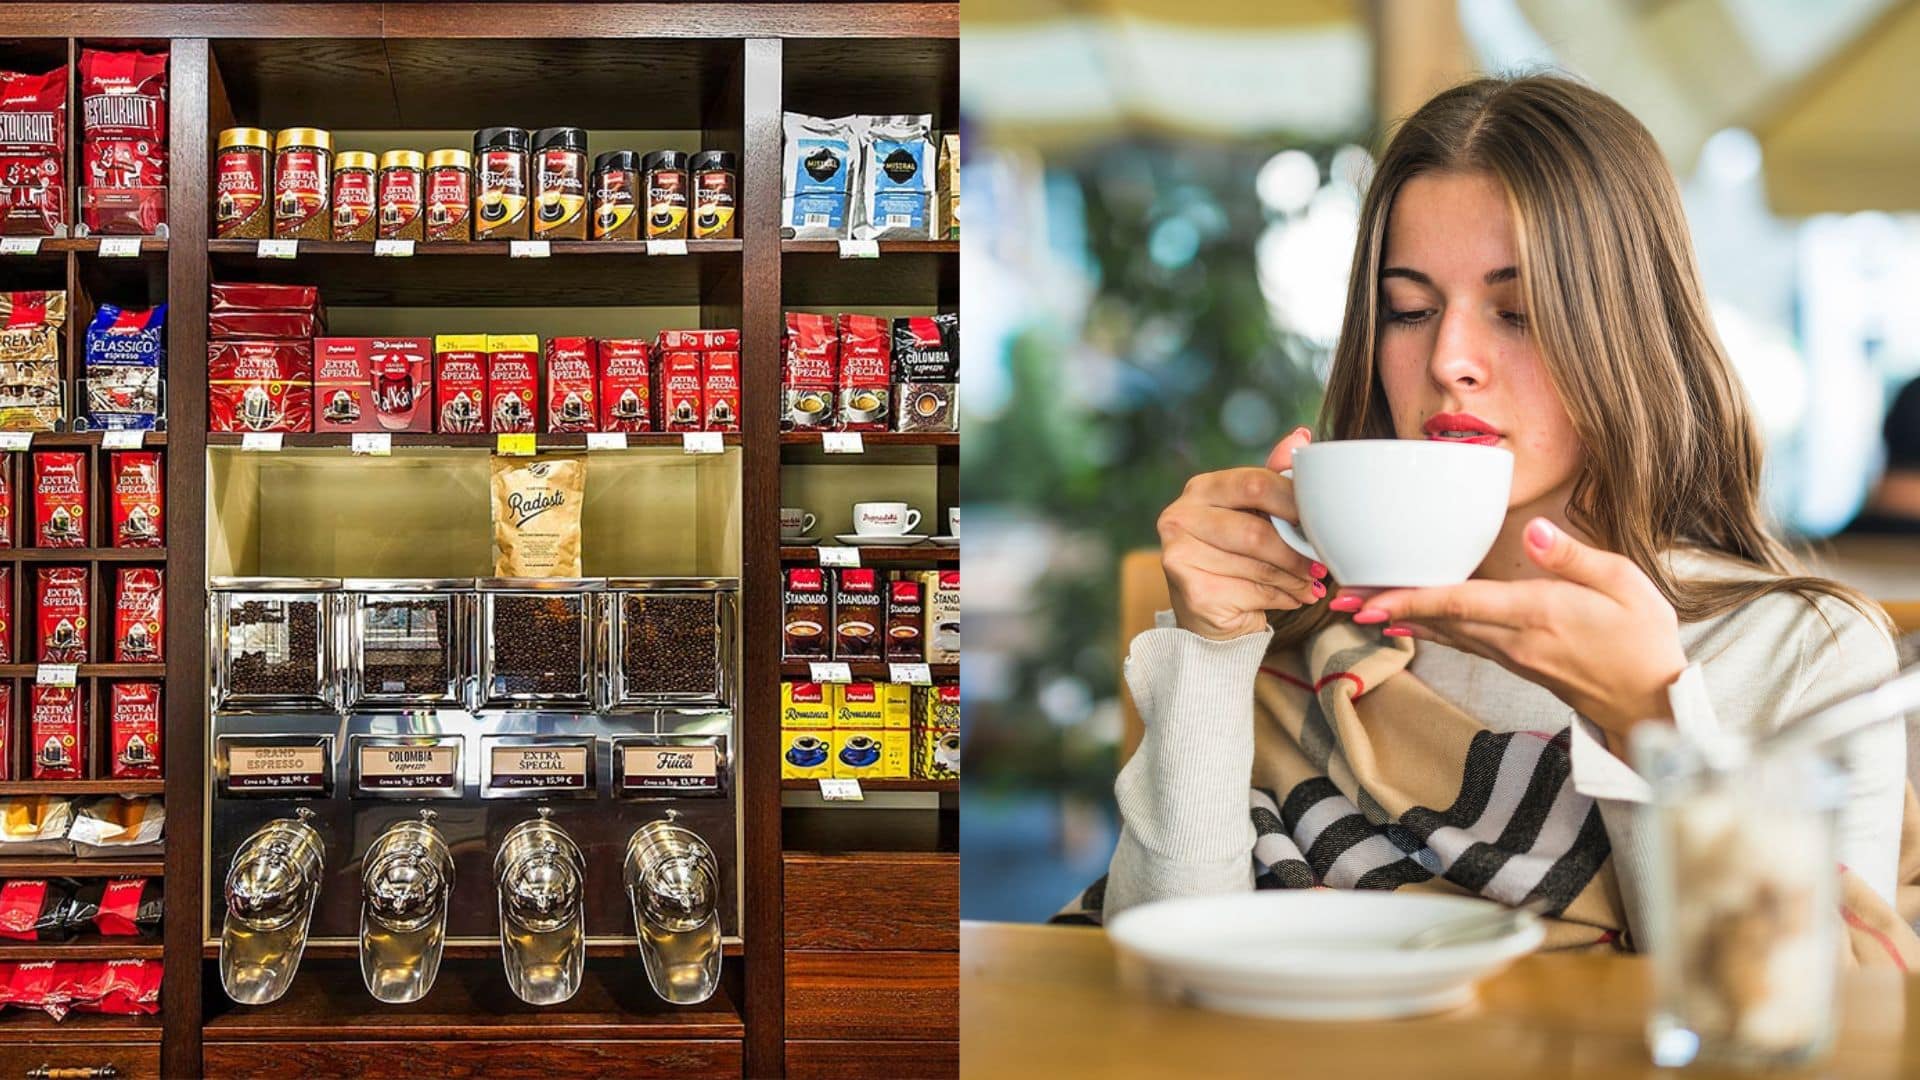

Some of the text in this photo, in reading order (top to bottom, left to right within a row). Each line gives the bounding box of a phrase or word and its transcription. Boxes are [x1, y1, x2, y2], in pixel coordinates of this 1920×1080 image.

[0, 115, 55, 144] STAURANT
[221, 171, 253, 180] EXTRA
[283, 170, 318, 180] EXTRA
[104, 353, 139, 361] espresso
[906, 351, 950, 364] COLOMBIA
[240, 358, 278, 368] EXTRA
[325, 359, 359, 369] EXTRA
[445, 362, 479, 371] EXTRA
[494, 362, 528, 371] EXTRA
[554, 360, 589, 369] EXTRA
[610, 358, 645, 367] EXTRA
[796, 359, 830, 368] EXTRA
[848, 358, 883, 367] EXTRA
[42, 475, 79, 484] EXTRA
[508, 489, 565, 519] Radosti
[47, 588, 82, 597] EXTRA
[121, 592, 157, 601] EXTRA
[785, 591, 828, 605] ŠTANDARD
[837, 591, 880, 605] ŠTANDARD
[36, 704, 71, 714] EXTRA
[117, 704, 152, 713] EXTRA
[255, 749, 296, 759] GRAND
[388, 751, 433, 762] COLOMBIA
[523, 750, 561, 760] EXTRA
[247, 759, 304, 770] ESPRESSO
[395, 762, 426, 771] espresso
[519, 759, 565, 770] ŠPECIÁL
